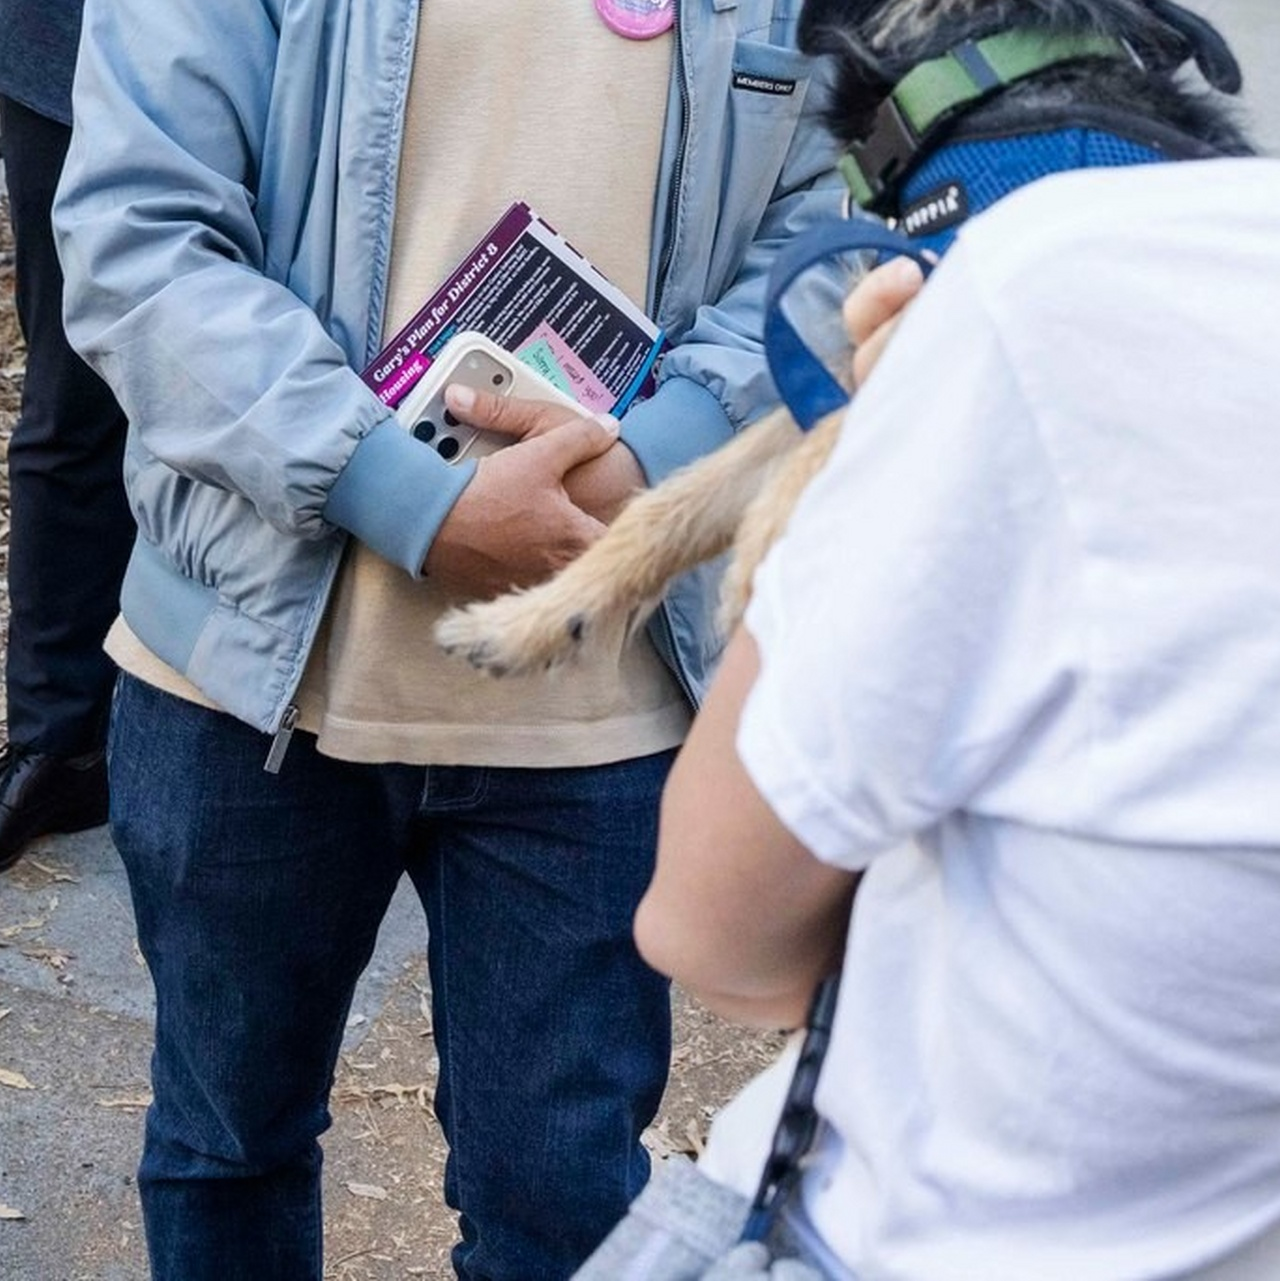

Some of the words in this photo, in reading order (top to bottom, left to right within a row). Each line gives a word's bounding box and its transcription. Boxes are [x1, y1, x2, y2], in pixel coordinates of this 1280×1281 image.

[373, 347, 410, 382] Gary's
[407, 321, 435, 348] Plan
[431, 299, 450, 325] for
[448, 253, 489, 302] District
[487, 243, 498, 256] 8
[379, 359, 424, 403] Housing
